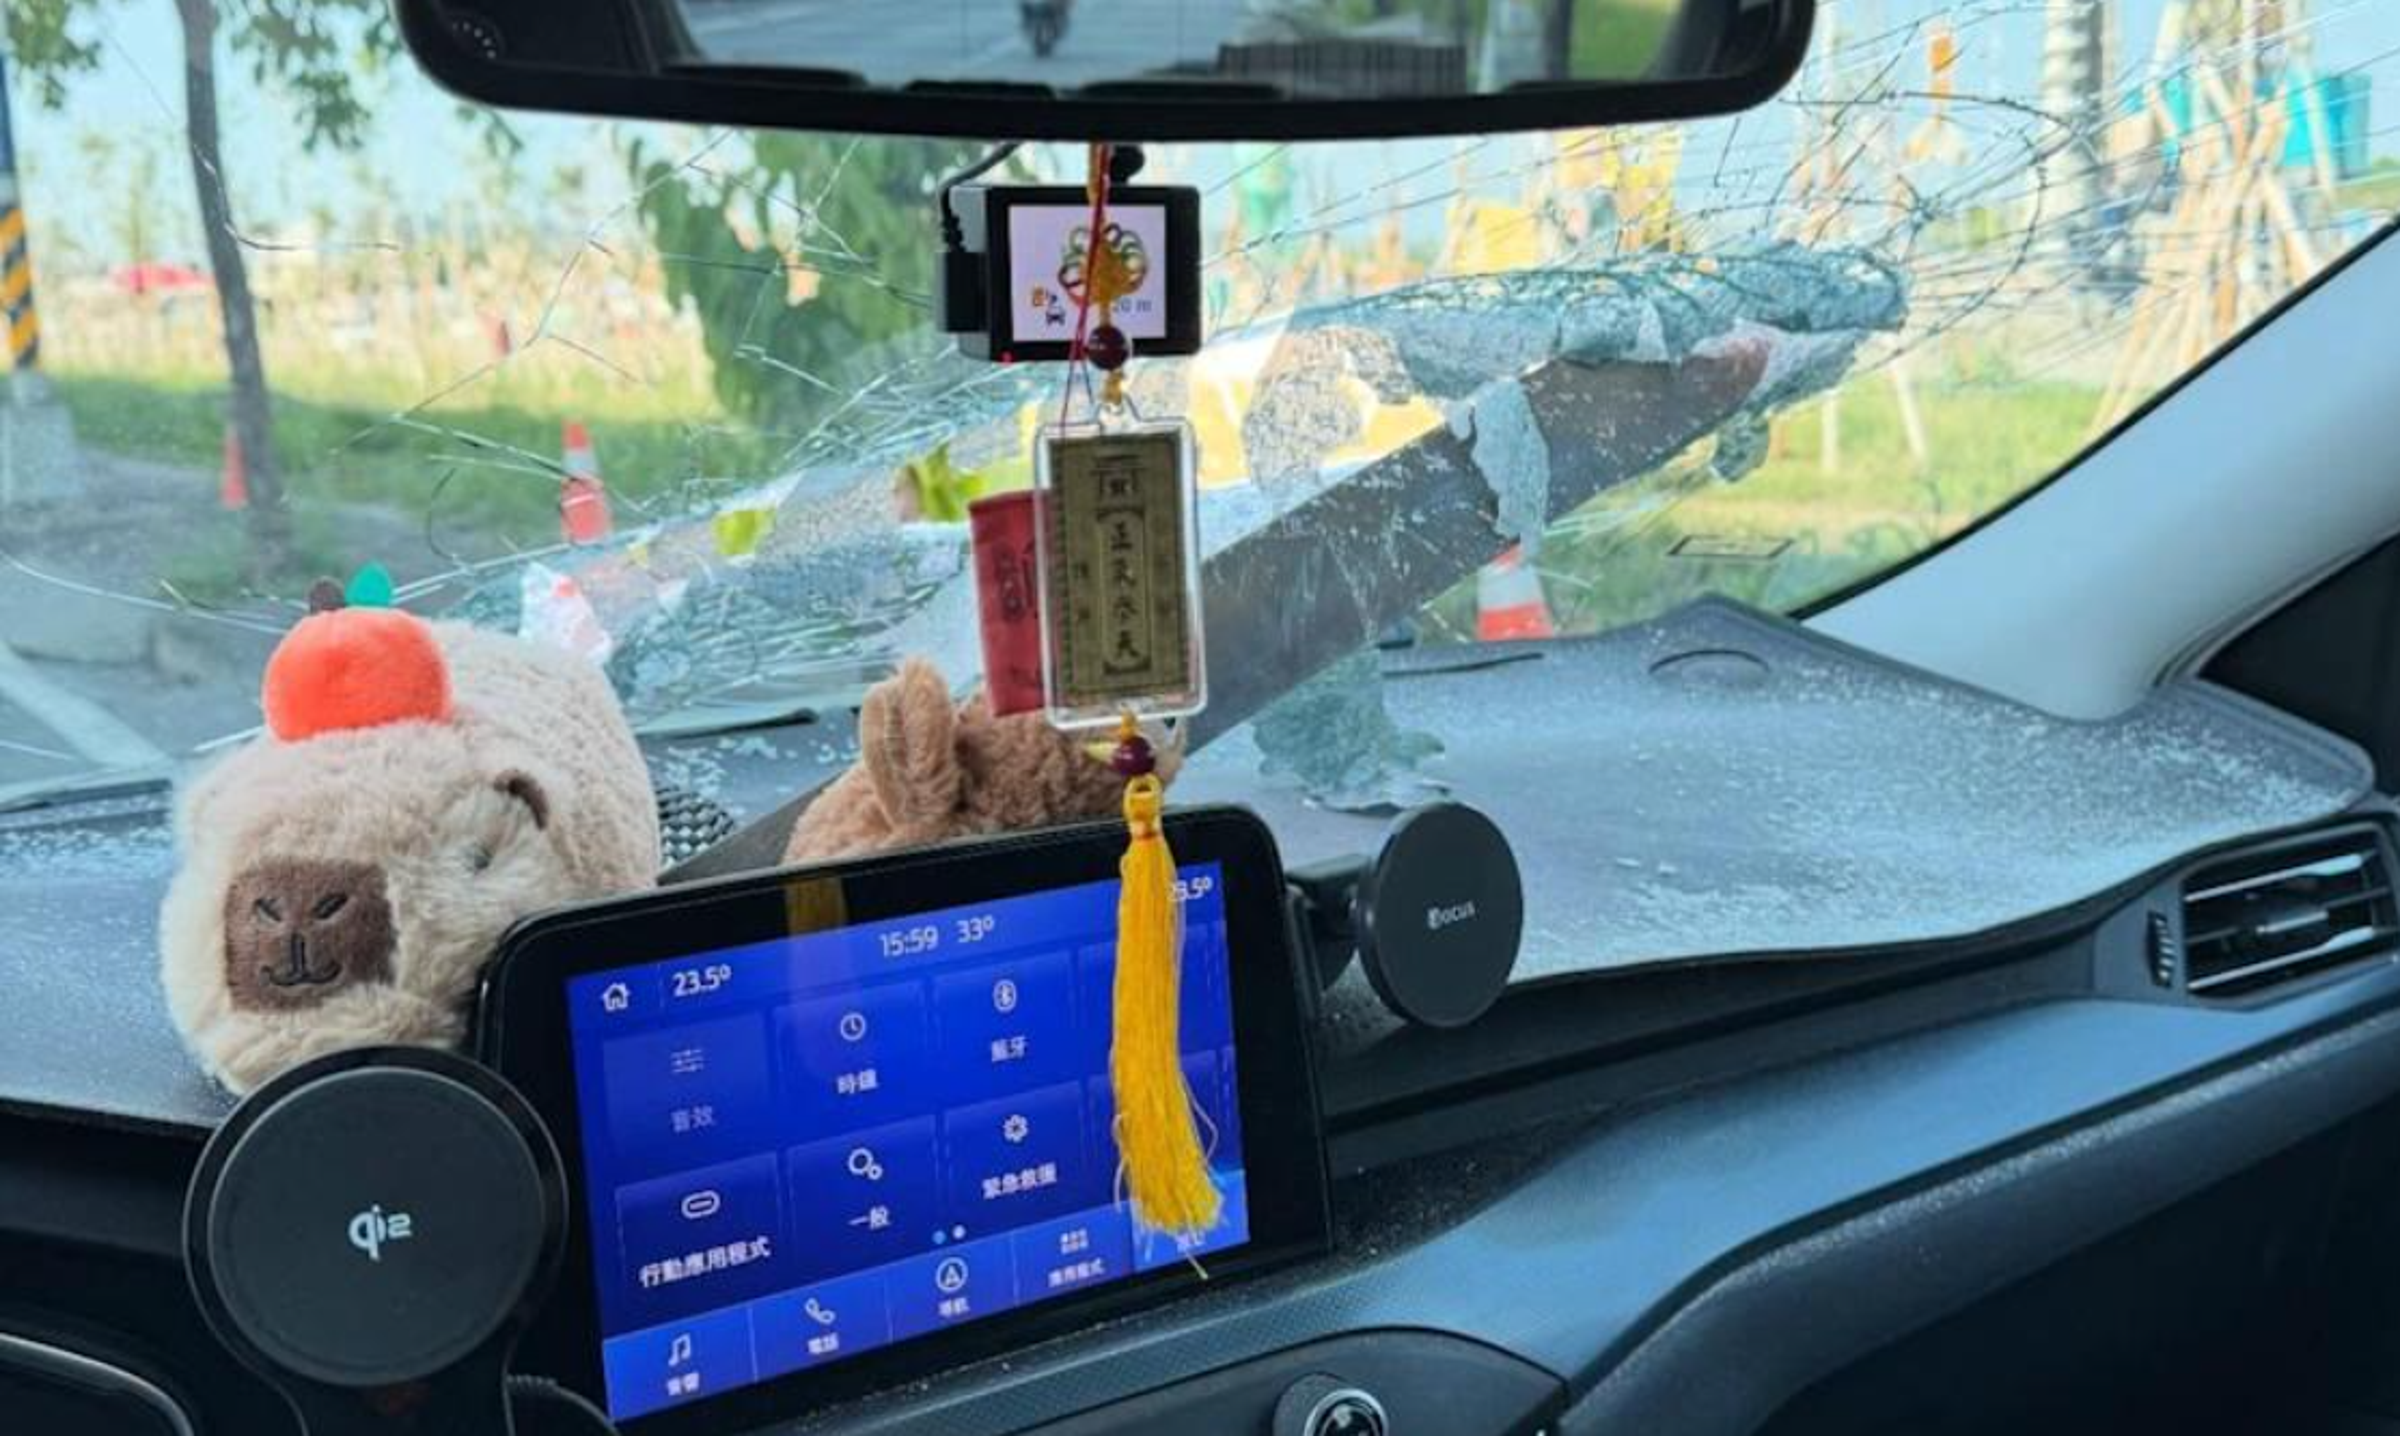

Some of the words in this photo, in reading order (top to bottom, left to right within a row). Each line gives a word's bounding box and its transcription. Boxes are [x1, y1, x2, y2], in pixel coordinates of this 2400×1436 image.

[880, 925, 939, 956] 15:59
[671, 1105, 715, 1133] 音效
[982, 1162, 1057, 1199] 緊急救援
[850, 1205, 890, 1230] 一般
[638, 1236, 772, 1288] 行動應用程式
